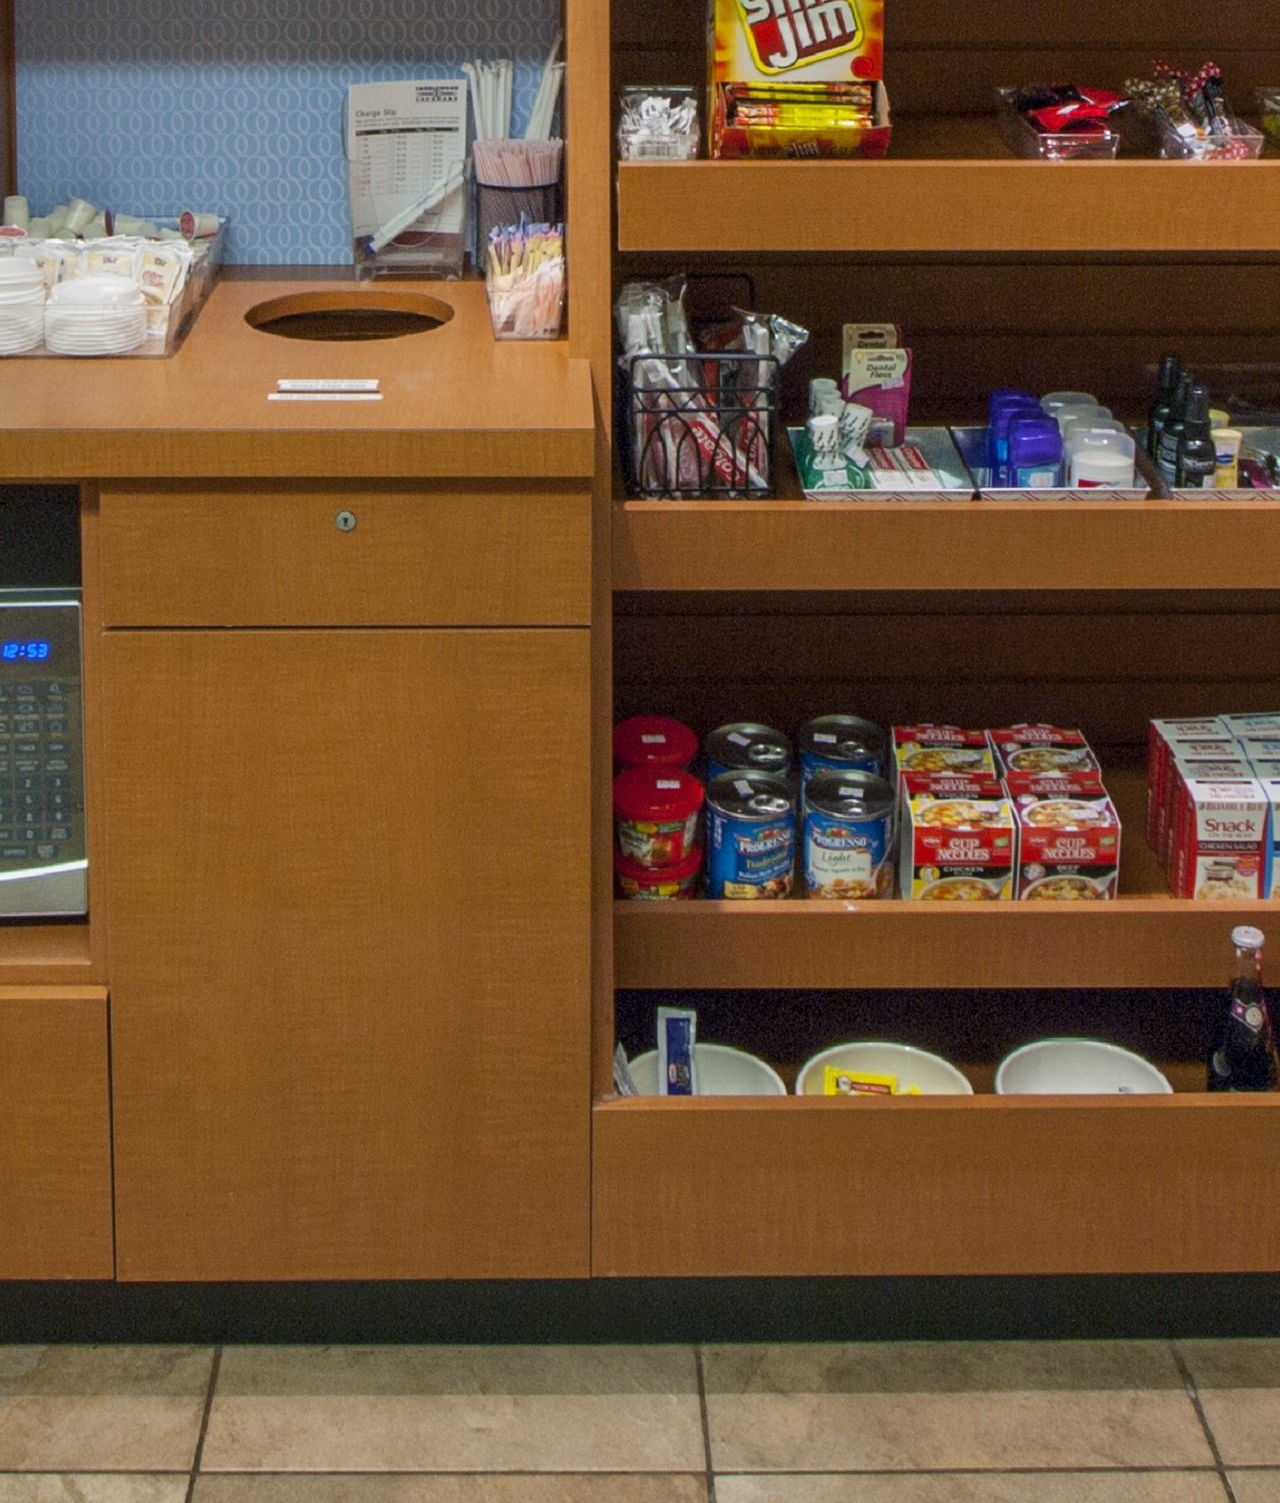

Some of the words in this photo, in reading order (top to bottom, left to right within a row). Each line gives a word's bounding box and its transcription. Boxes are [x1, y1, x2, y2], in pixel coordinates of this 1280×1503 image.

[355, 109, 381, 120] Charge
[383, 108, 397, 118] Slip
[866, 364, 897, 373] Dental
[1, 642, 50, 659] 12:53
[1204, 818, 1256, 833] Snack
[949, 837, 980, 849] CUP
[1055, 837, 1087, 849] CUP
[821, 851, 852, 866] Light
[936, 848, 990, 861] NOODLES
[1043, 848, 1096, 860] NOODLES
